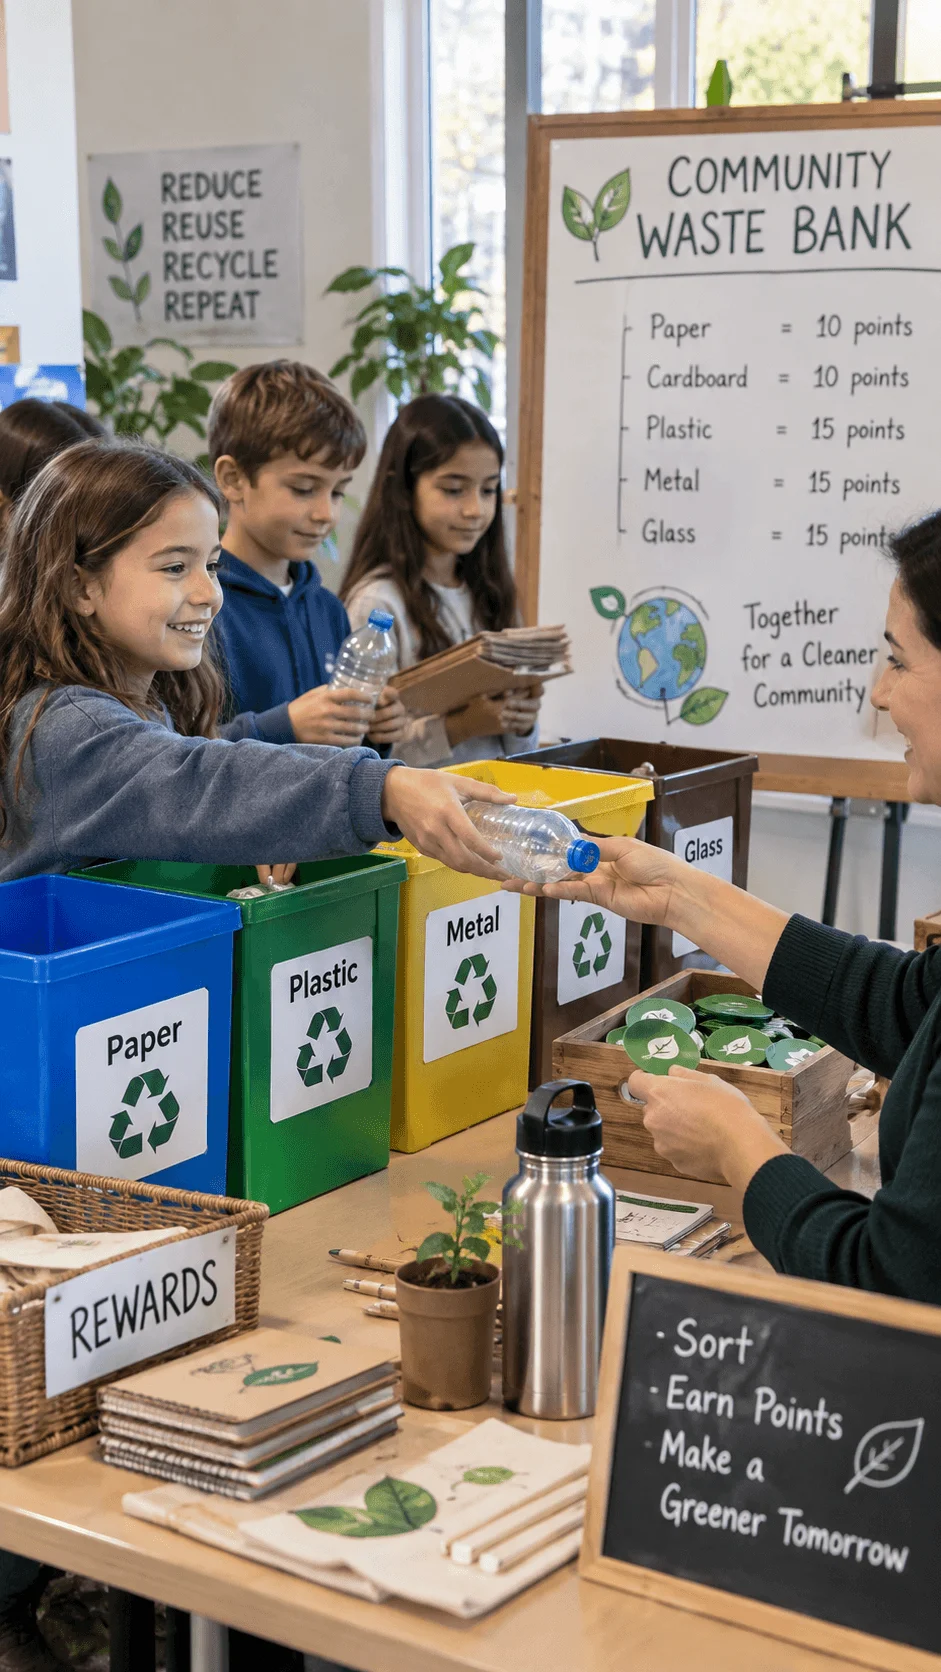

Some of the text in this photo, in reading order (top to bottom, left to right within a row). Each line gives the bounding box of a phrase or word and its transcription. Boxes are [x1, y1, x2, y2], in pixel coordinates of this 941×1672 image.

[161, 168, 262, 204] REDUCE
[667, 150, 892, 198] COMMUNITY
[162, 209, 244, 242] REUSE
[636, 202, 912, 260] WASTE BANK
[163, 248, 279, 282] RECYCLE
[164, 290, 260, 322] REPEAT
[650, 312, 712, 348] Paper
[816, 313, 842, 338] 10
[853, 313, 913, 346] points
[647, 364, 748, 389] Cardboard
[814, 364, 839, 389] 10
[850, 364, 910, 396] points
[646, 414, 713, 440] Plastic
[812, 416, 835, 440] 15
[846, 417, 906, 449] points
[644, 467, 700, 492] Metal
[809, 470, 831, 494] 15
[842, 471, 901, 502] points
[641, 517, 696, 545] Glass
[807, 523, 829, 547] 15
[743, 600, 839, 639] Together
[741, 641, 879, 672] for a Cleaner
[753, 678, 867, 715] Community
[684, 837, 723, 864] Glass
[446, 904, 500, 947] Metal
[289, 958, 358, 1004] Plastic
[107, 1020, 182, 1066] Paper
[70, 1259, 218, 1359] REWARDS
[673, 1317, 754, 1365] Sort
[666, 1374, 843, 1440] Earn Points
[659, 1429, 765, 1483] Make a
[660, 1483, 909, 1573] Greener Tomorrow
